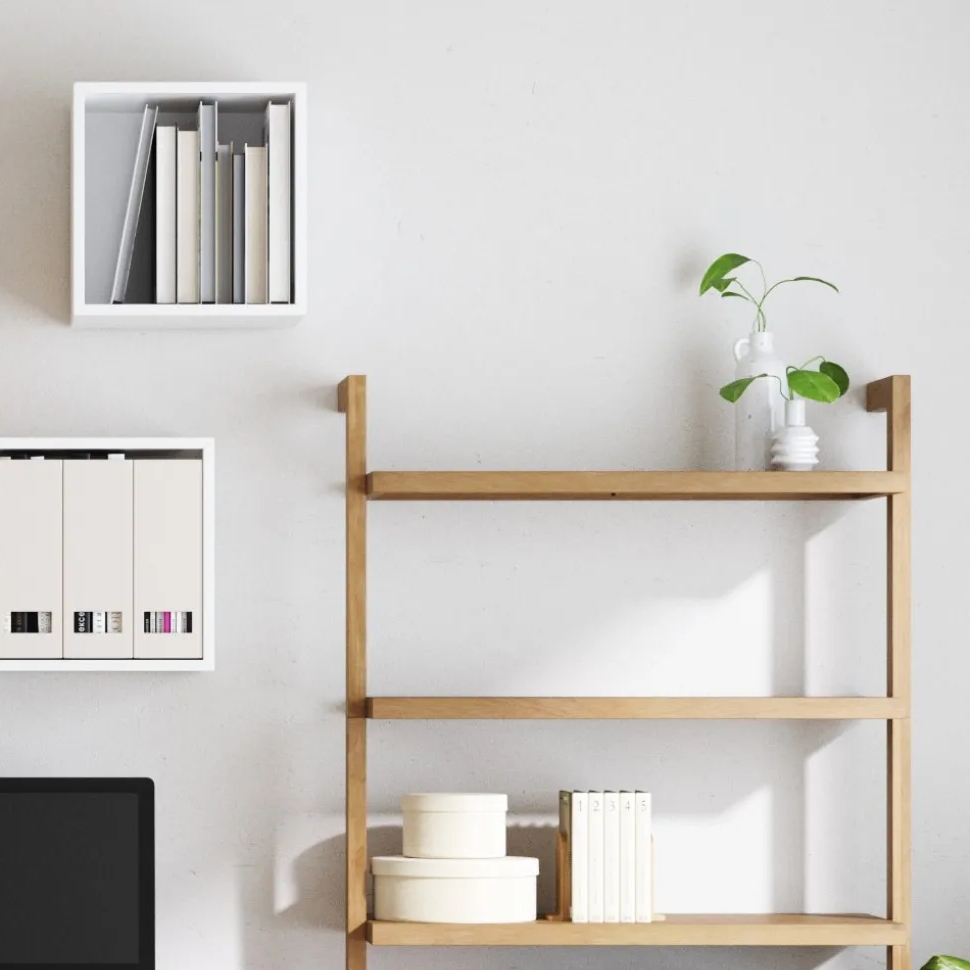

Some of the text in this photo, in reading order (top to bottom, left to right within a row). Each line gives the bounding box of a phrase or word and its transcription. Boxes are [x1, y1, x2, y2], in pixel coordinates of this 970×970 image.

[578, 800, 583, 812] 1
[593, 800, 600, 812] 2
[609, 800, 616, 812] 3
[625, 800, 631, 812] 4
[641, 800, 648, 812] 5
